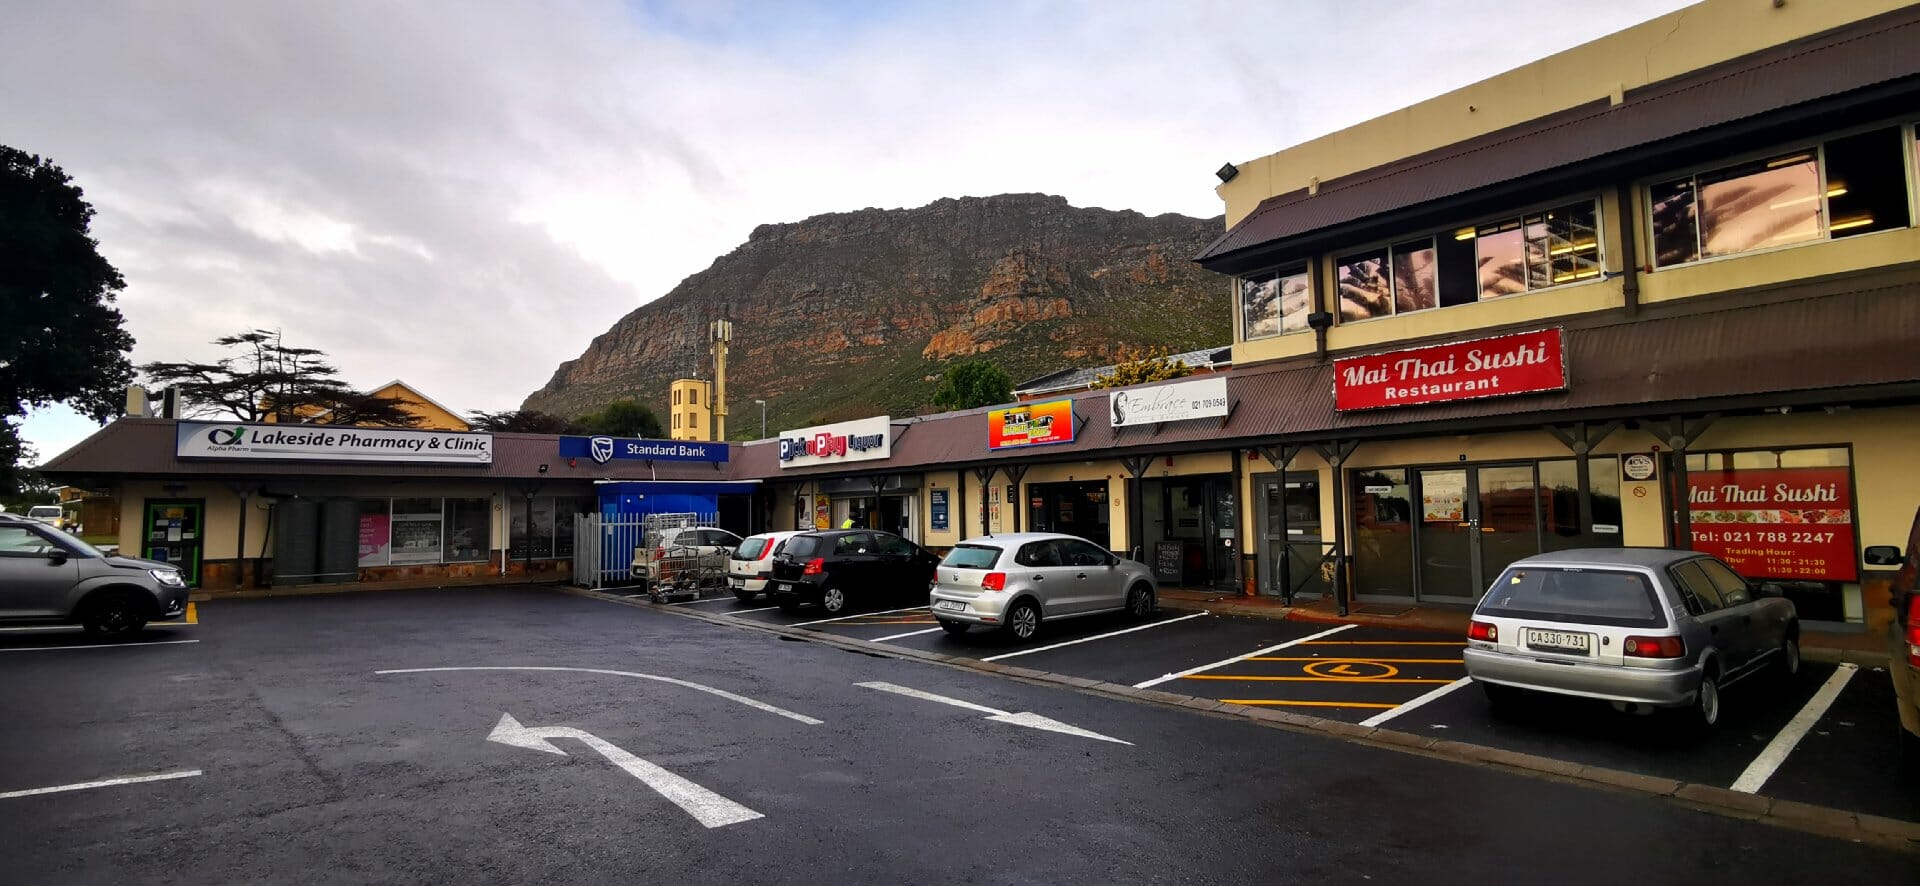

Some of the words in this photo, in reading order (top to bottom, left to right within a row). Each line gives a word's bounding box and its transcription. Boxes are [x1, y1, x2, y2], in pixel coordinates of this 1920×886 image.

[1343, 364, 1391, 387] Mai
[1395, 353, 1459, 381] Thai
[1465, 341, 1550, 372] Sushi
[1385, 375, 1499, 400] Restaurant
[251, 429, 334, 447] Lakeside
[339, 431, 425, 452] Pharmacy
[428, 437, 440, 449] &
[444, 437, 487, 451] Clinic
[848, 434, 884, 452] Liquor
[627, 443, 677, 457] Standard
[680, 445, 705, 458] Bank
[1720, 484, 1769, 503] Thai
[1774, 482, 1839, 503] Sushi
[1692, 531, 1719, 542] Tel:
[1723, 532, 1751, 543] 021
[1757, 532, 1787, 543] 788
[1792, 532, 1835, 543] 2247
[1725, 547, 1764, 556] Trading
[1766, 548, 1796, 556] Hour:
[1530, 631, 1585, 647] CA330-731
